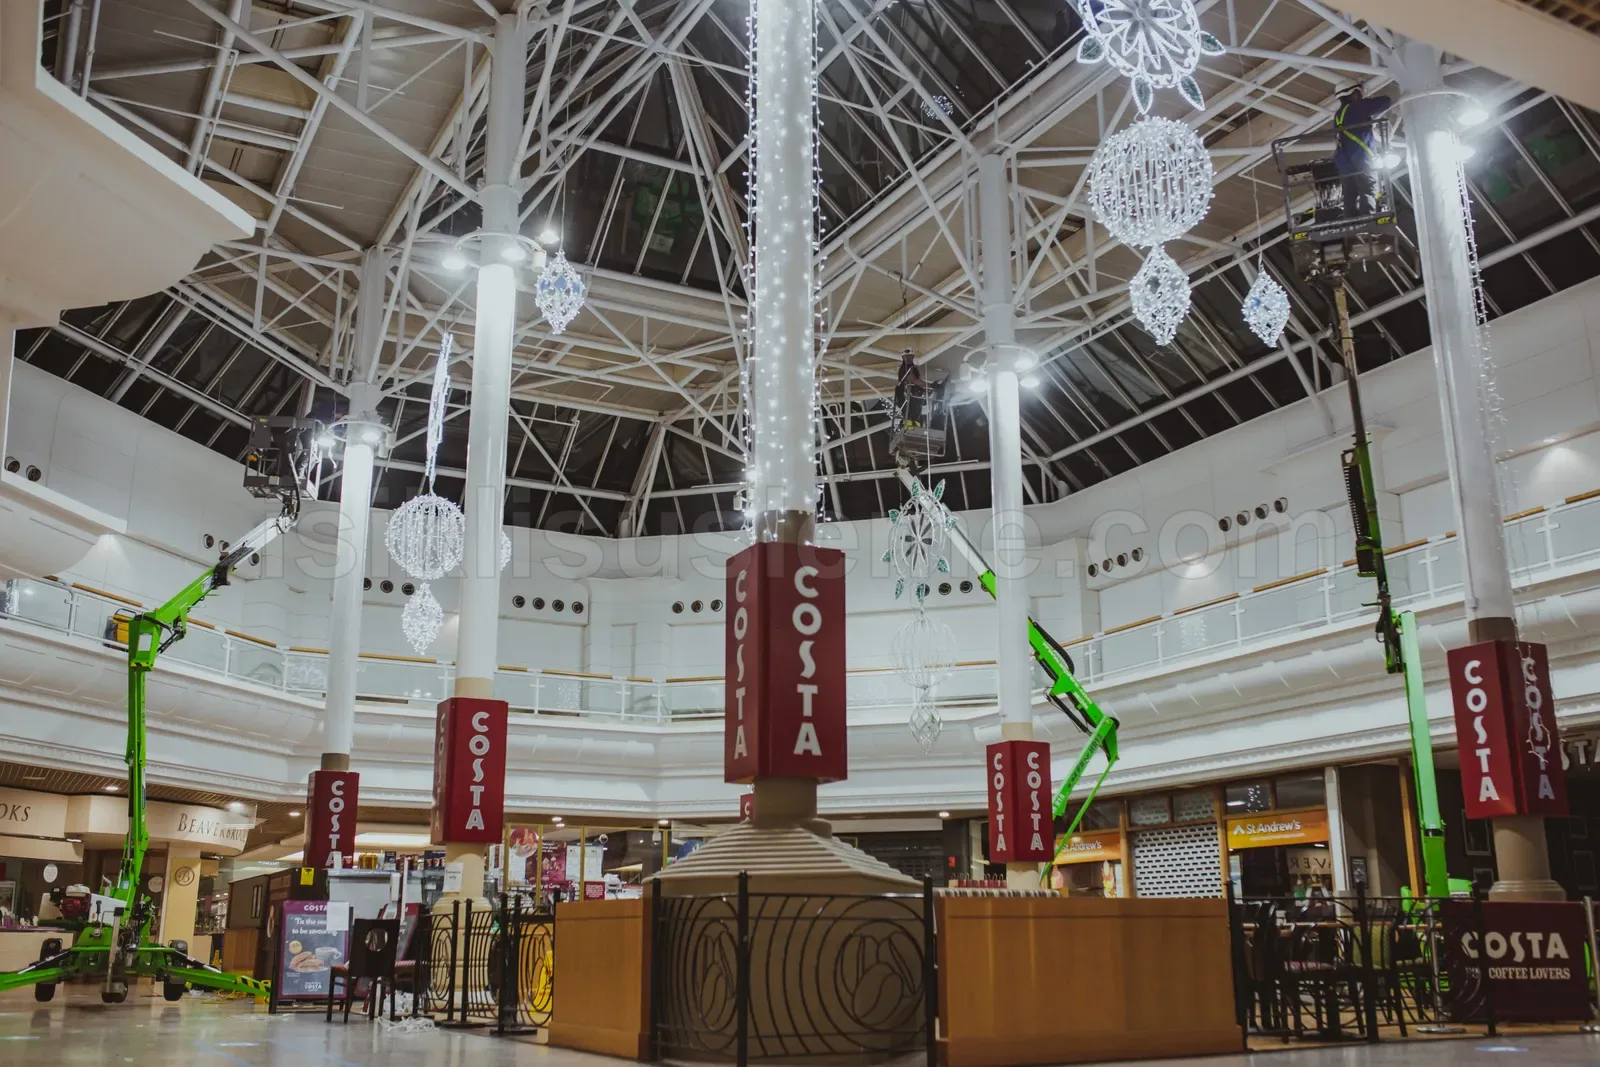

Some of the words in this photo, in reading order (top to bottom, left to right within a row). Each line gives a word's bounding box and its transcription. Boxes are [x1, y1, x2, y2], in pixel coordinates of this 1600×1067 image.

[734, 569, 748, 760] COSTA
[792, 565, 822, 757] COSTA
[465, 711, 490, 830] COSTA
[1464, 659, 1500, 802] COSTA
[1521, 656, 1555, 800] COSTA
[994, 752, 1007, 852] COSTA
[1027, 751, 1044, 851] COSTA
[1070, 840, 1102, 852] Andrew's
[1246, 823, 1257, 835] St
[1258, 820, 1301, 833] Andrew's
[1461, 931, 1569, 963] COSTA
[1488, 967, 1528, 980] COFFEE
[1529, 967, 1571, 980] LOVERS
